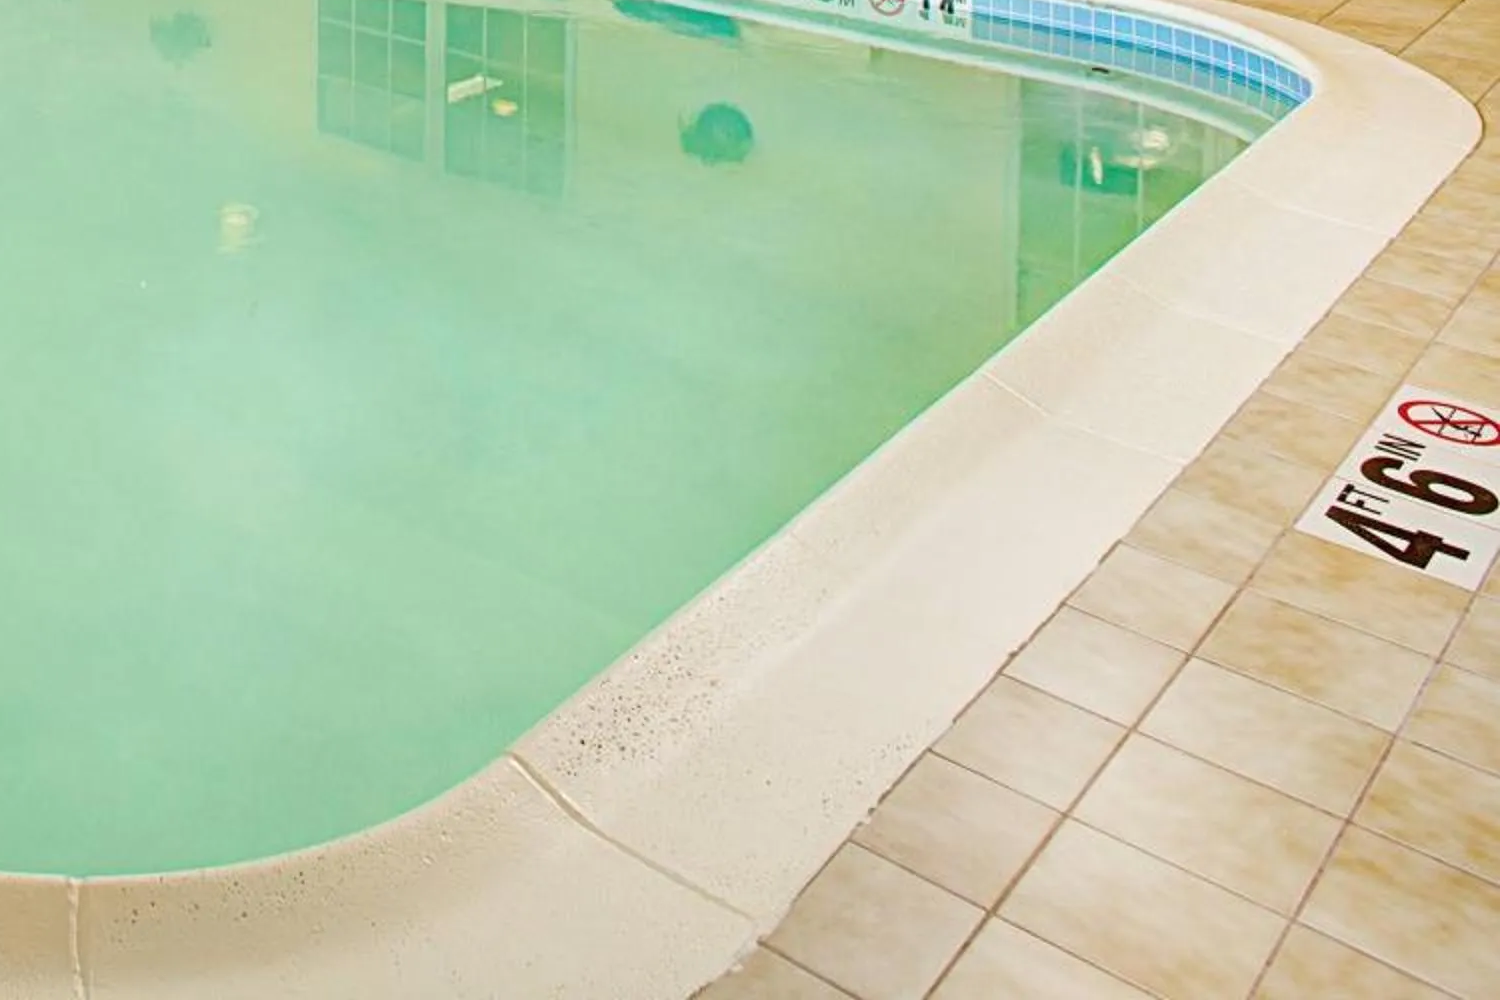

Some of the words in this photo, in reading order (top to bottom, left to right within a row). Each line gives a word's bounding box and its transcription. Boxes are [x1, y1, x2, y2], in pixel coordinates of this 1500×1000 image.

[1374, 433, 1426, 461] IN
[1336, 483, 1389, 515] FT
[1360, 455, 1499, 516] 6
[1324, 505, 1470, 569] 4
